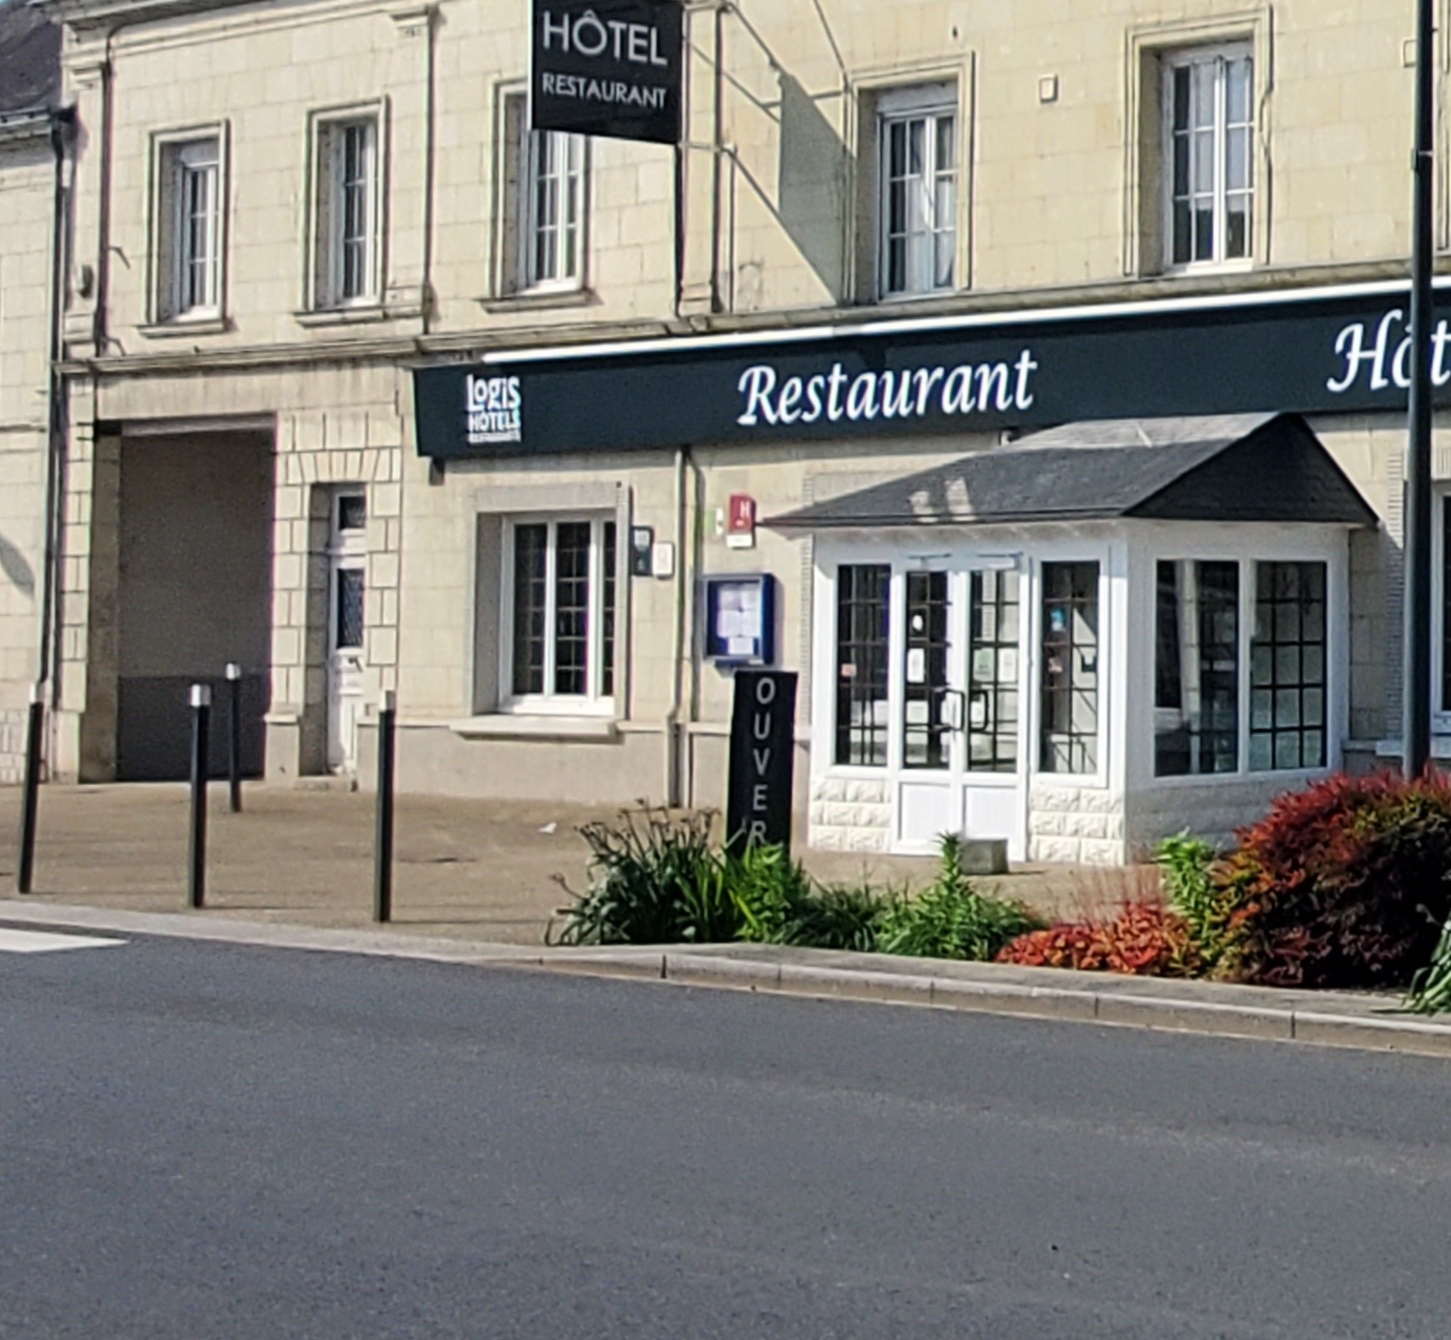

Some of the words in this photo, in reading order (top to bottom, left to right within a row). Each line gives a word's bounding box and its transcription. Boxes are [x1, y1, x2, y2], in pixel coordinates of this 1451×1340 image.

[542, 9, 669, 66] HÔTEL
[541, 72, 667, 108] RESTAURANT
[736, 349, 1038, 425] Restaurant
